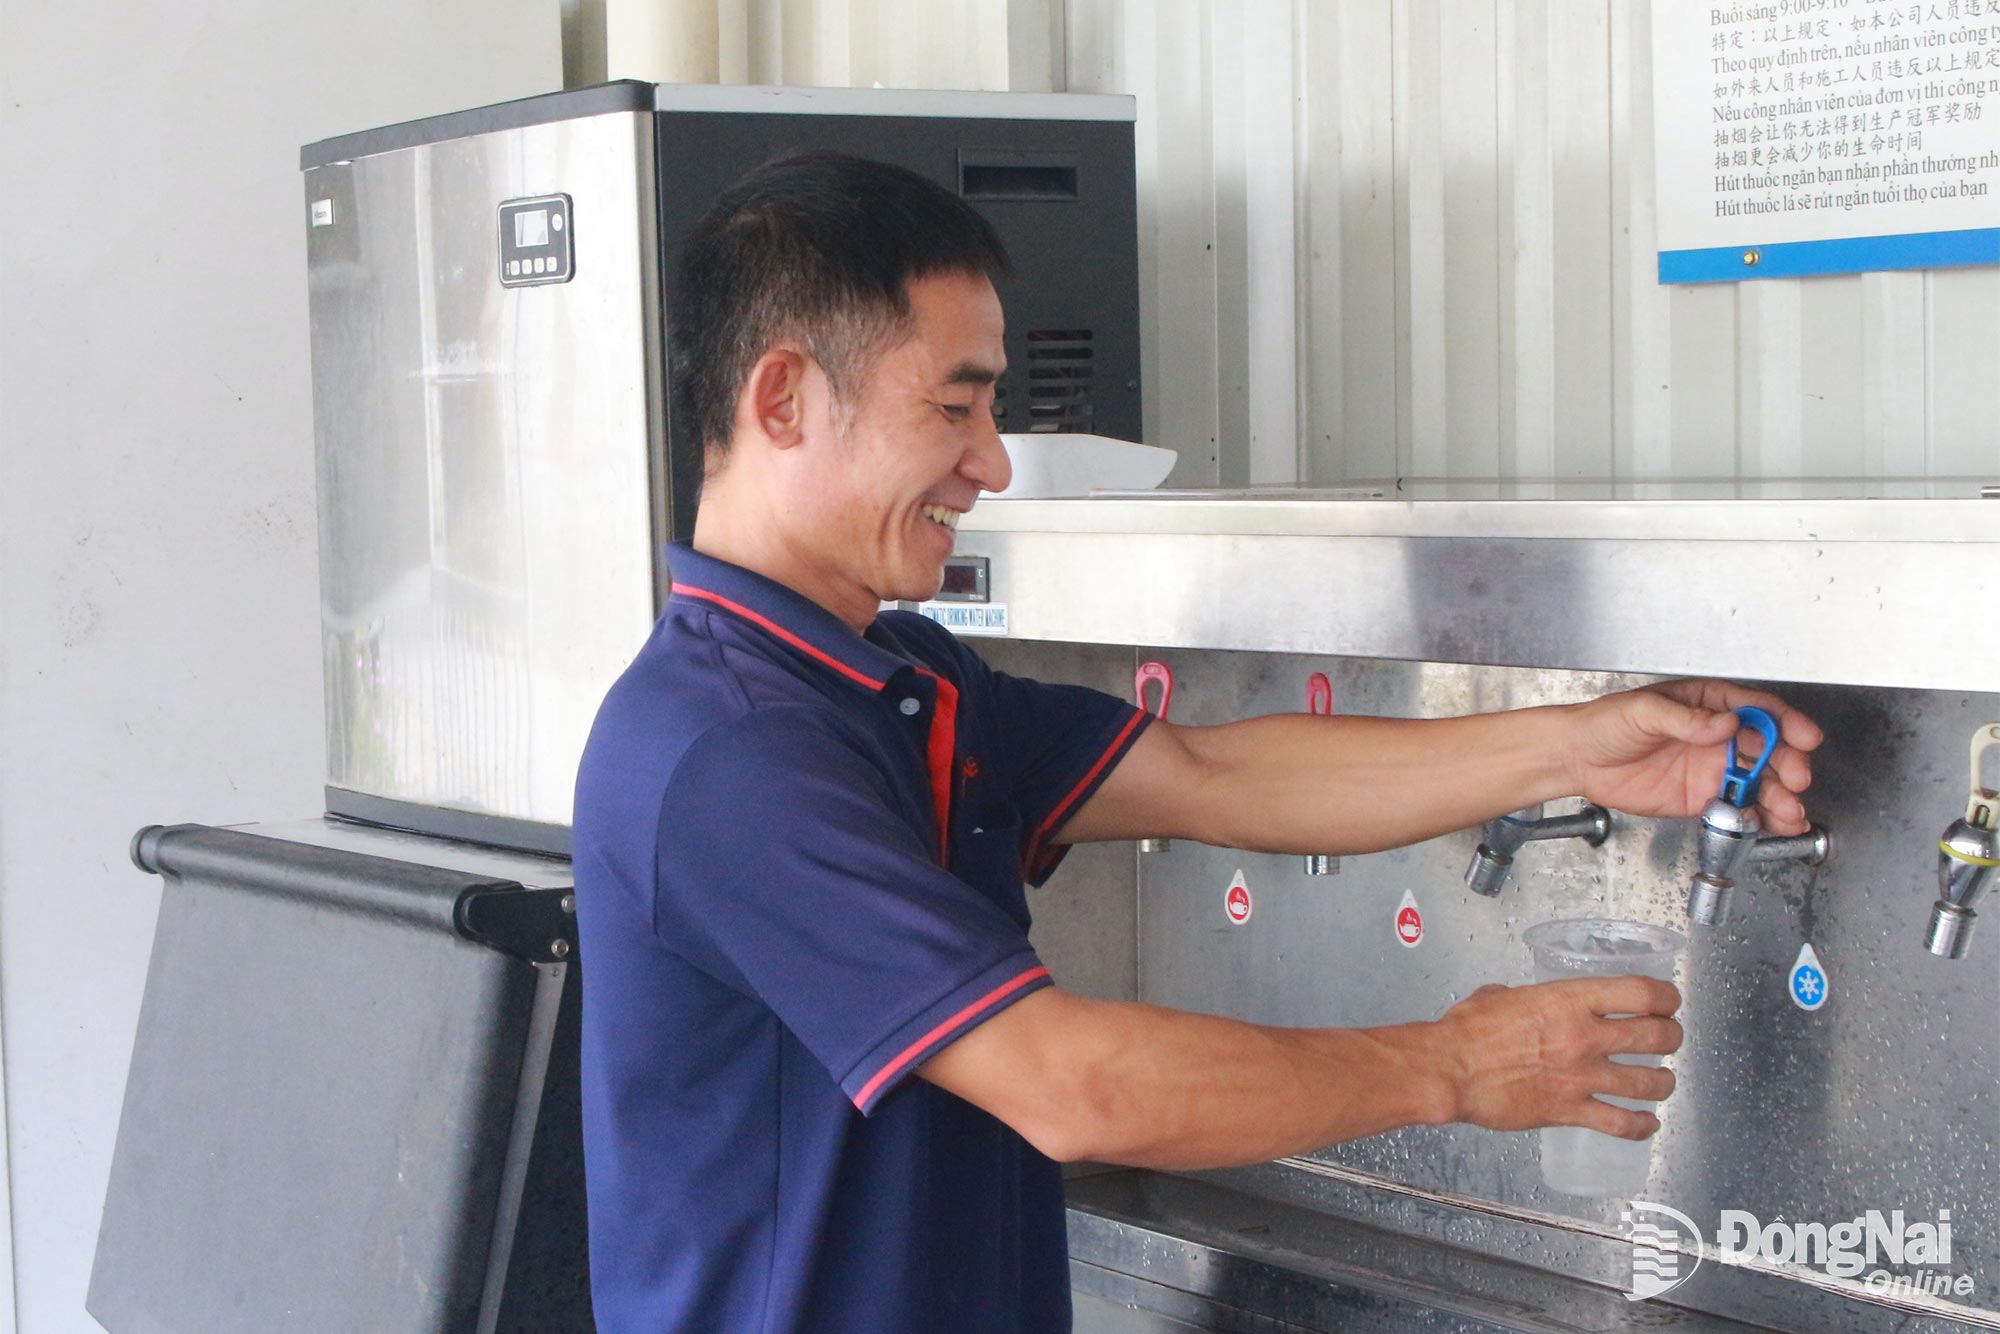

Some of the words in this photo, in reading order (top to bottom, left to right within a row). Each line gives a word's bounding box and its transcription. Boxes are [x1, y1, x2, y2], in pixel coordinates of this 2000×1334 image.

[1711, 1, 1742, 26] Buổi
[1746, 3, 1777, 22] sáng
[1711, 57, 1746, 74] Theo
[1748, 55, 1774, 74] quy
[1776, 47, 1808, 69] định
[1810, 44, 1842, 63] trên,
[1845, 34, 1871, 58] nếu
[1874, 34, 1910, 54] nhân
[1913, 29, 1946, 49] viên
[1949, 25, 1988, 46] công
[1712, 100, 1741, 123] Nếu
[1743, 102, 1777, 121] công
[1779, 97, 1812, 116] nhân
[1815, 92, 1845, 111] viên
[1847, 89, 1873, 108] của
[1875, 87, 1903, 105] đơn
[1907, 82, 1921, 104] vị
[1924, 80, 1944, 99] thi
[1947, 77, 1986, 99] công
[1714, 130, 1922, 170] 抽烟更会减少你的生命时间
[1715, 174, 1740, 192] Hút
[1743, 166, 1780, 189] thuốc
[1783, 169, 1815, 190] ngăn
[1818, 166, 1843, 186] bạn
[1846, 161, 1880, 182] nhận
[1883, 153, 1919, 182] phần
[1922, 153, 1977, 175] thưởng
[1716, 199, 1741, 217] Hút
[1744, 192, 1780, 215] thuốc
[1783, 194, 1795, 212] lá
[1797, 193, 1812, 210] sẽ
[1814, 192, 1833, 209] rút
[1836, 183, 1870, 212] ngắn
[1873, 180, 1901, 204] tuổi
[1904, 184, 1927, 204] thọ
[1930, 181, 1957, 199] của
[1960, 180, 1988, 200] bạn
